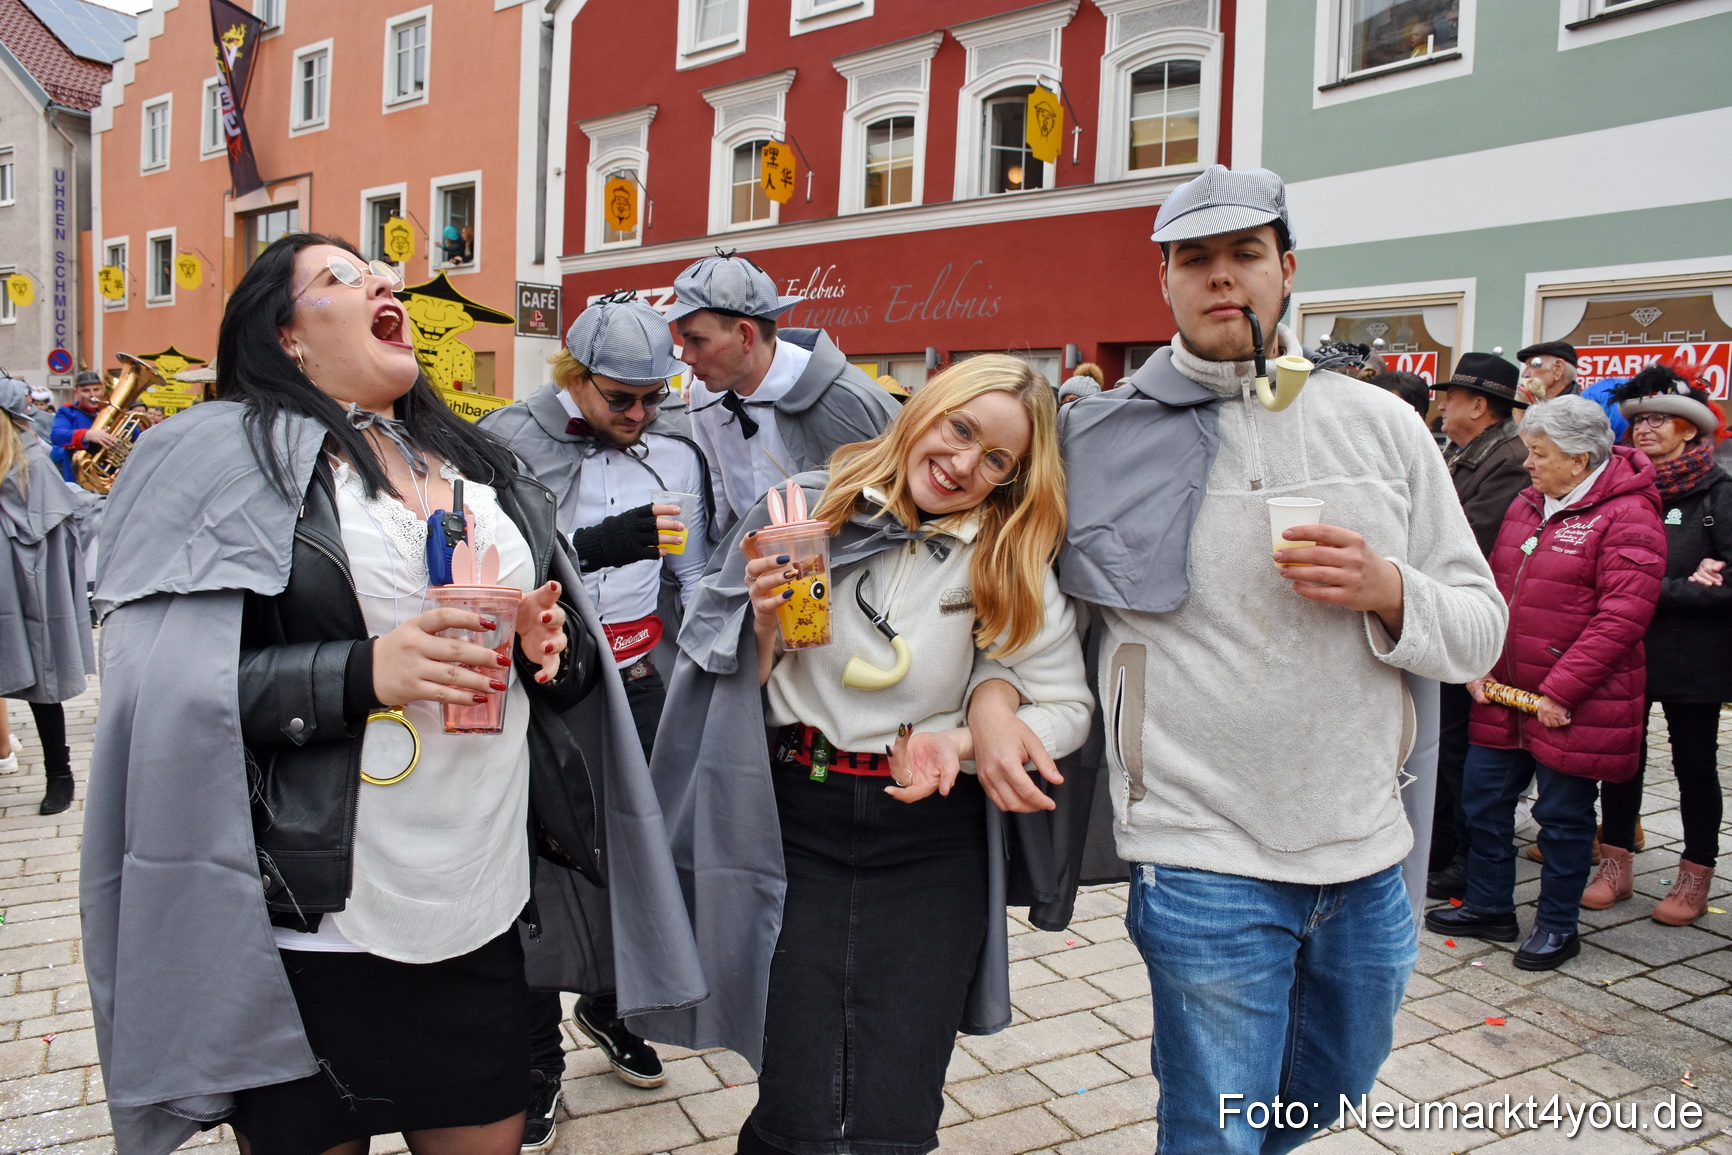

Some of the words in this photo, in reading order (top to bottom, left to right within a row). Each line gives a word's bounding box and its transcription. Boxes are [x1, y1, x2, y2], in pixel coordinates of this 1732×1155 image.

[55, 170, 65, 240] UHREN
[785, 264, 846, 300] Erlebnis
[884, 260, 1002, 323] Erlebnis
[55, 251, 66, 349] SCHMUCK
[522, 290, 556, 310] CAFÉ
[1588, 330, 1706, 345] RÖHLICH
[1576, 354, 1662, 376] STARK
[1555, 515, 1602, 534] Sail
